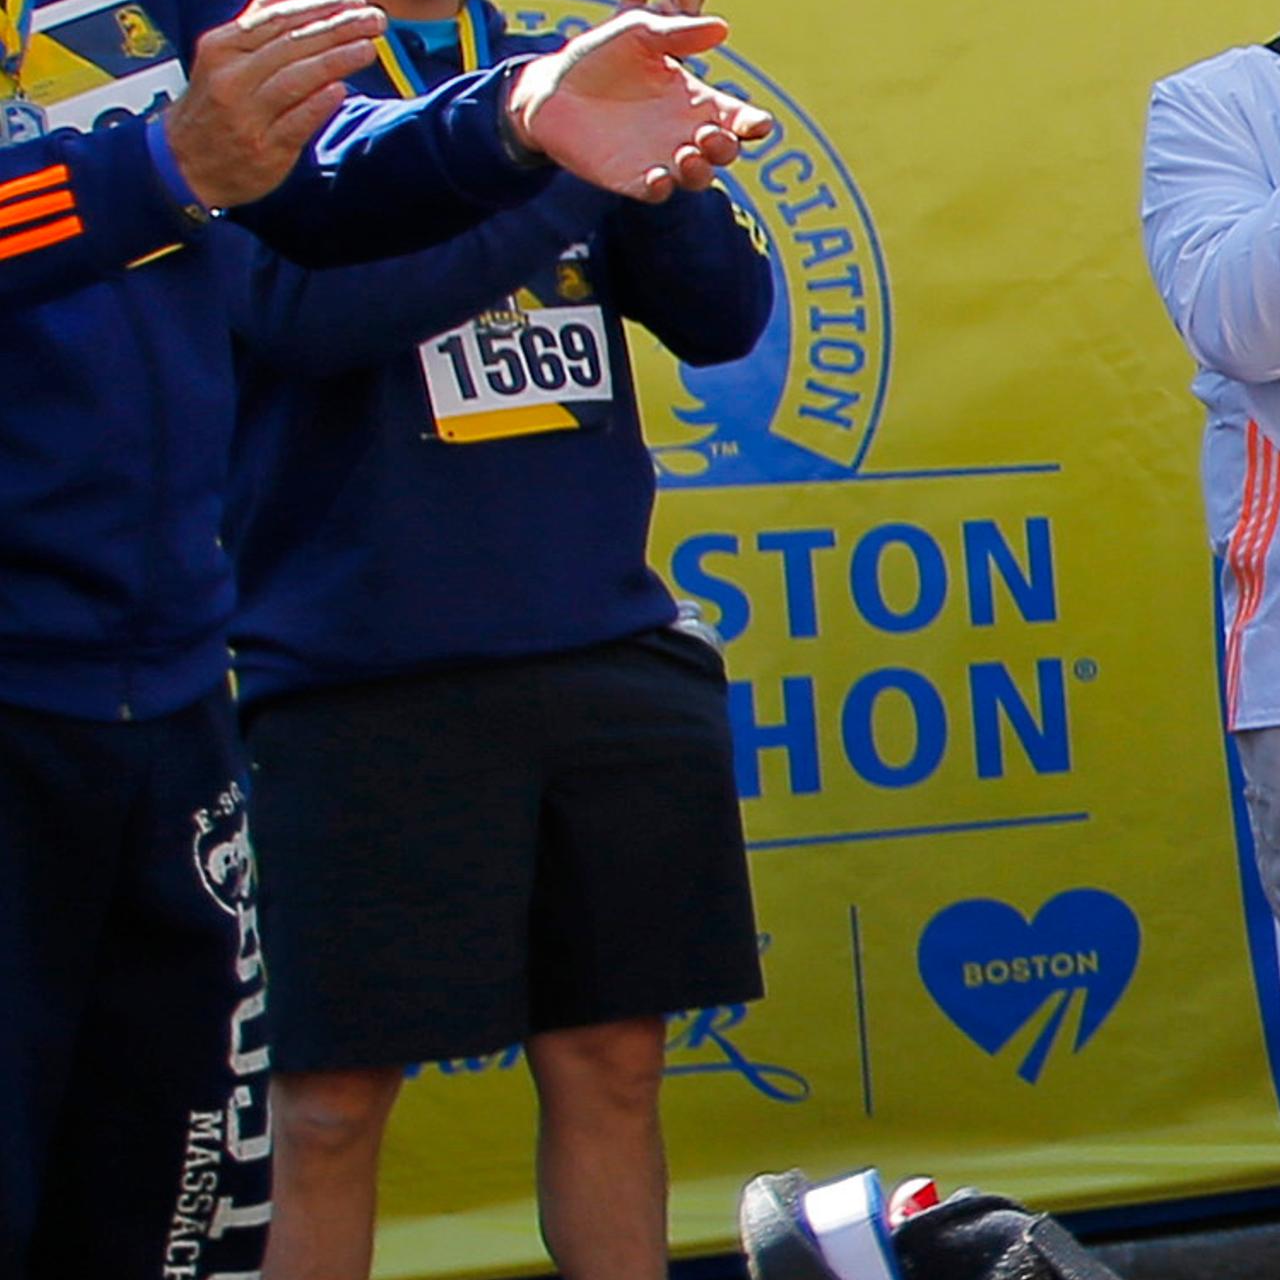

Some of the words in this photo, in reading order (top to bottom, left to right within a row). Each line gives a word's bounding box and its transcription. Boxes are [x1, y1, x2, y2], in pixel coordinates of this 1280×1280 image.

[437, 323, 602, 400] 1569
[670, 516, 1059, 647] STON
[962, 949, 1099, 989] BOSTON
